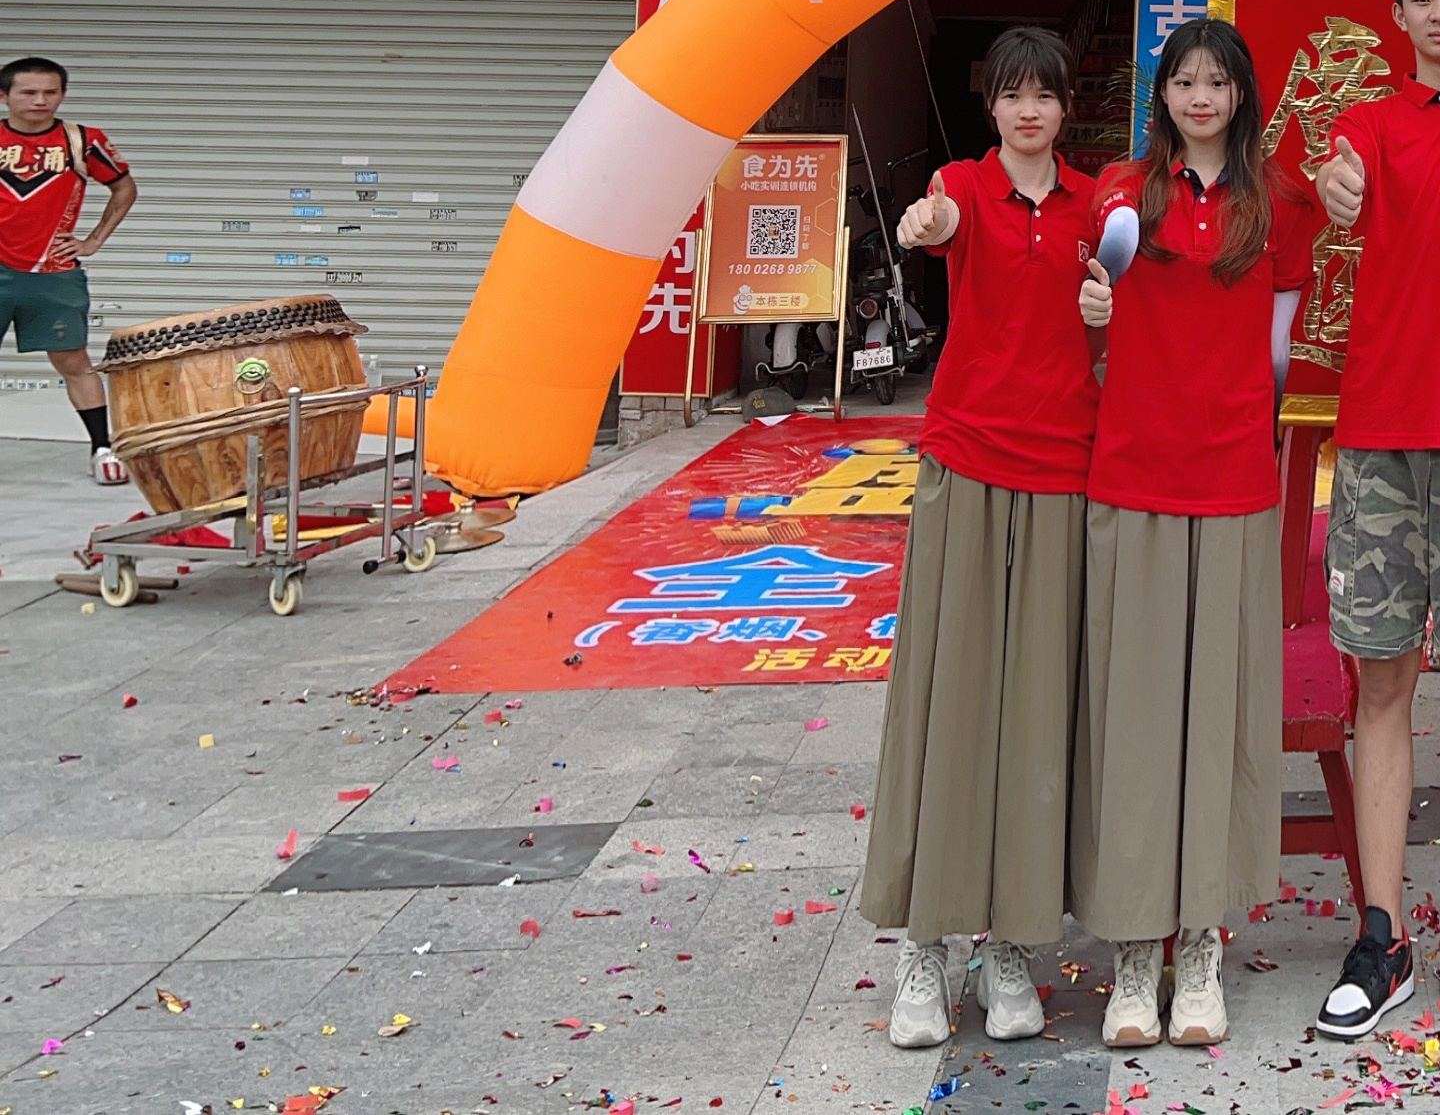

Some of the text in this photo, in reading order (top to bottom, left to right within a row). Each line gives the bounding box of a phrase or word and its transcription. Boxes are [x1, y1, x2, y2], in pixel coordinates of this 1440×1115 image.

[743, 154, 818, 179] 食为先
[728, 264, 750, 275] 180
